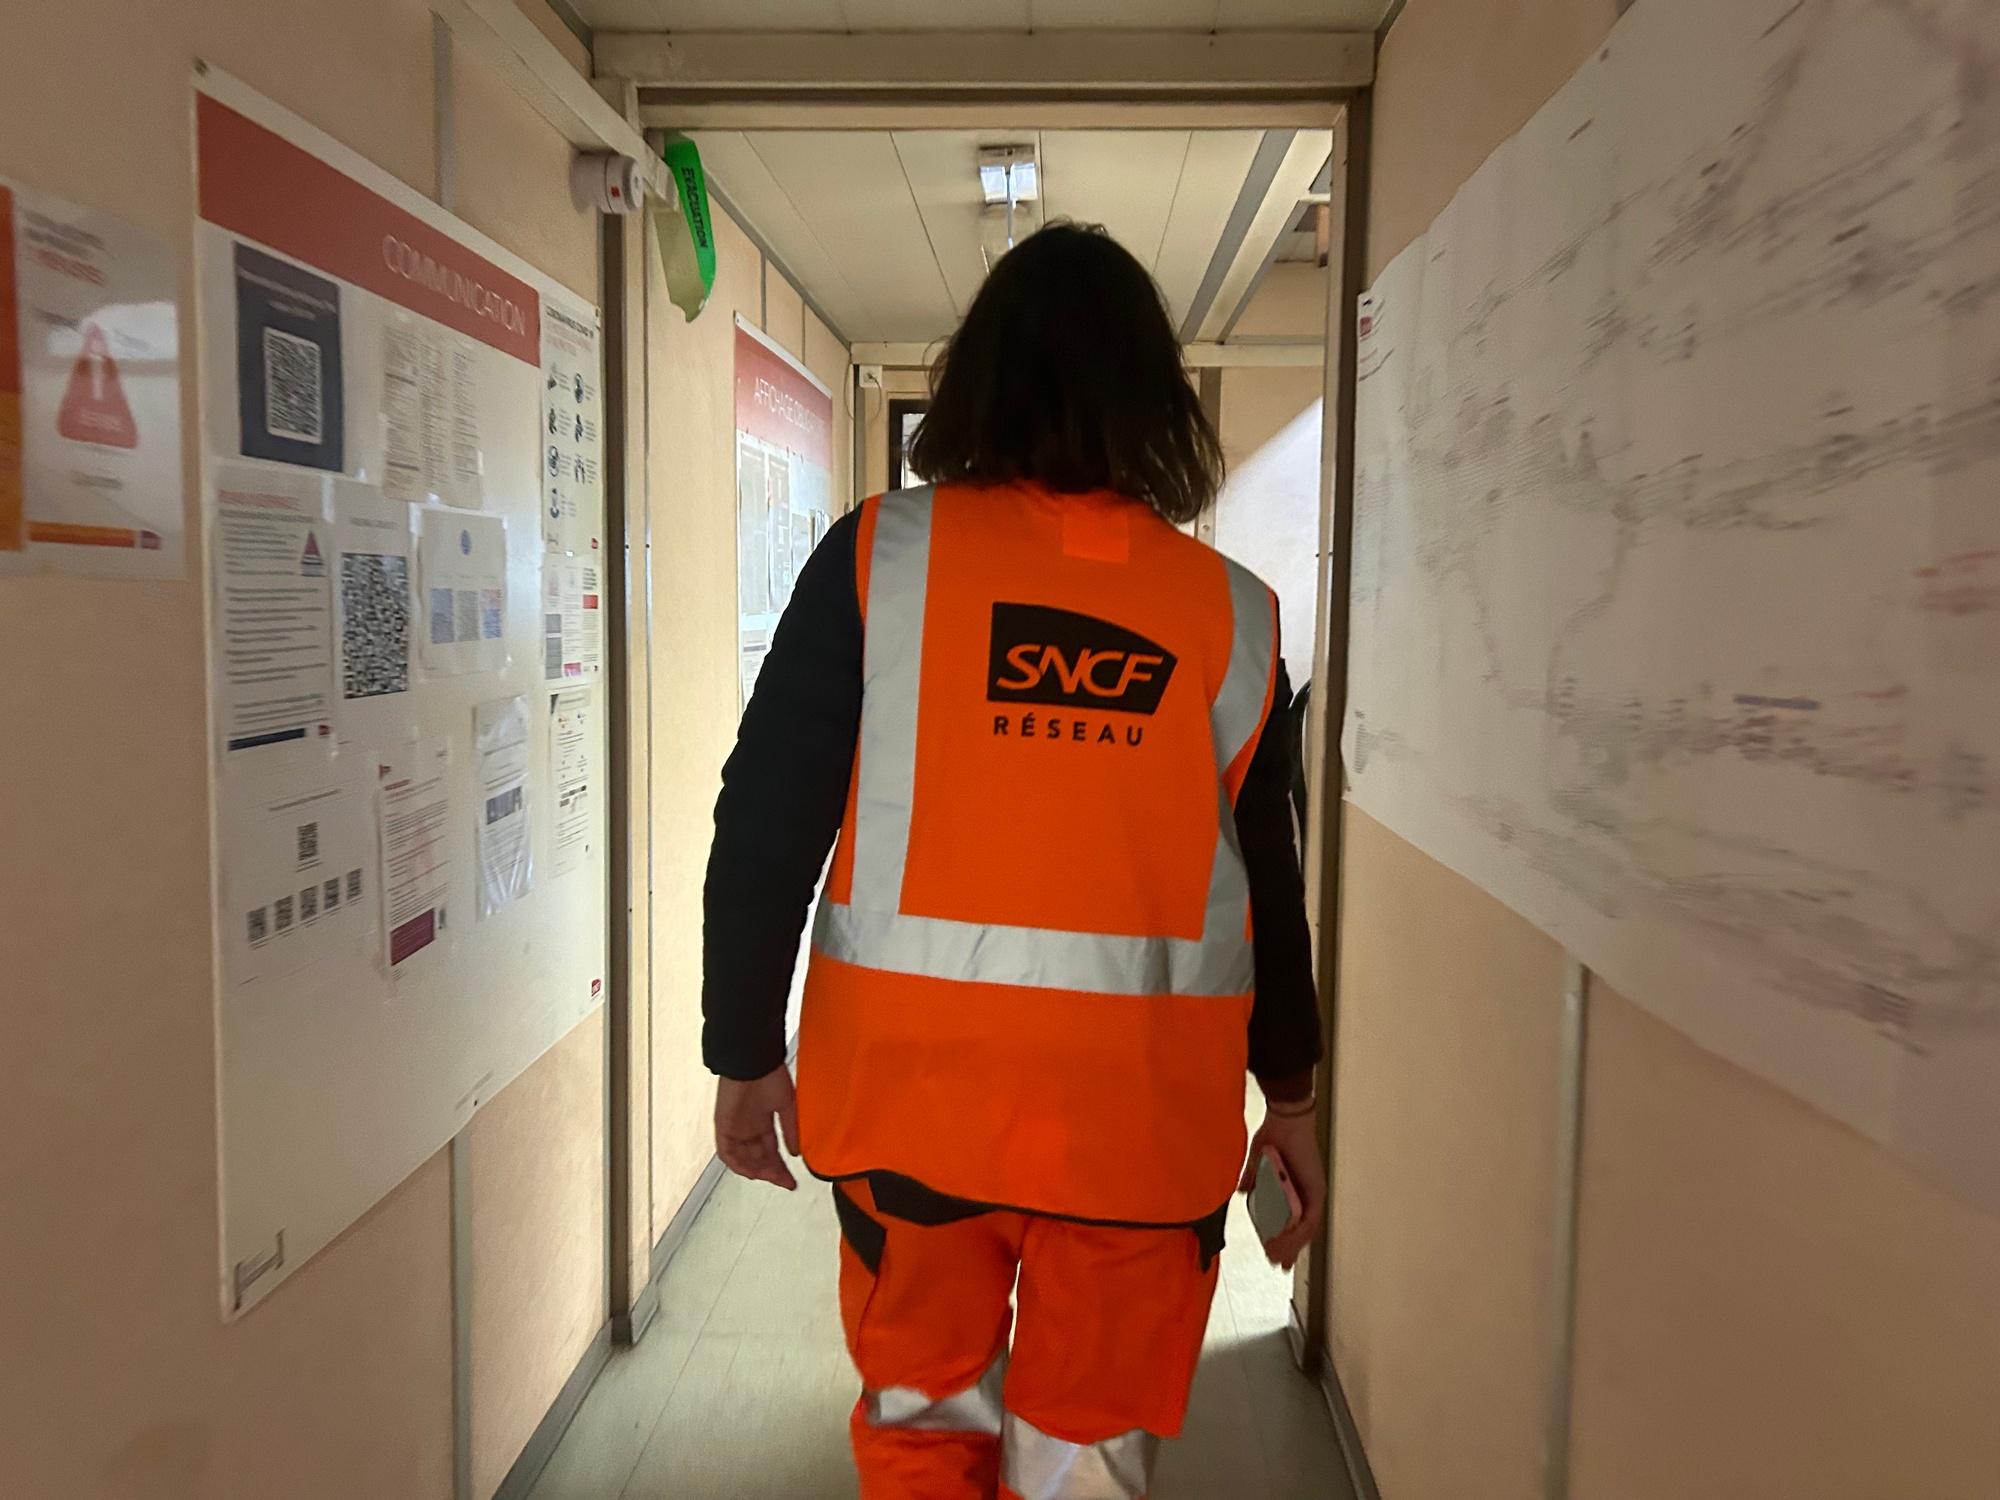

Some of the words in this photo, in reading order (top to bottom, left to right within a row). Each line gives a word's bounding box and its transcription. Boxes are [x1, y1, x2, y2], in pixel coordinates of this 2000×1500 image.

[681, 167, 708, 248] EVACUATION
[382, 234, 526, 336] COMMUNICATION
[997, 643, 1164, 697] SNCF
[993, 712, 1144, 747] RÉSEAU
